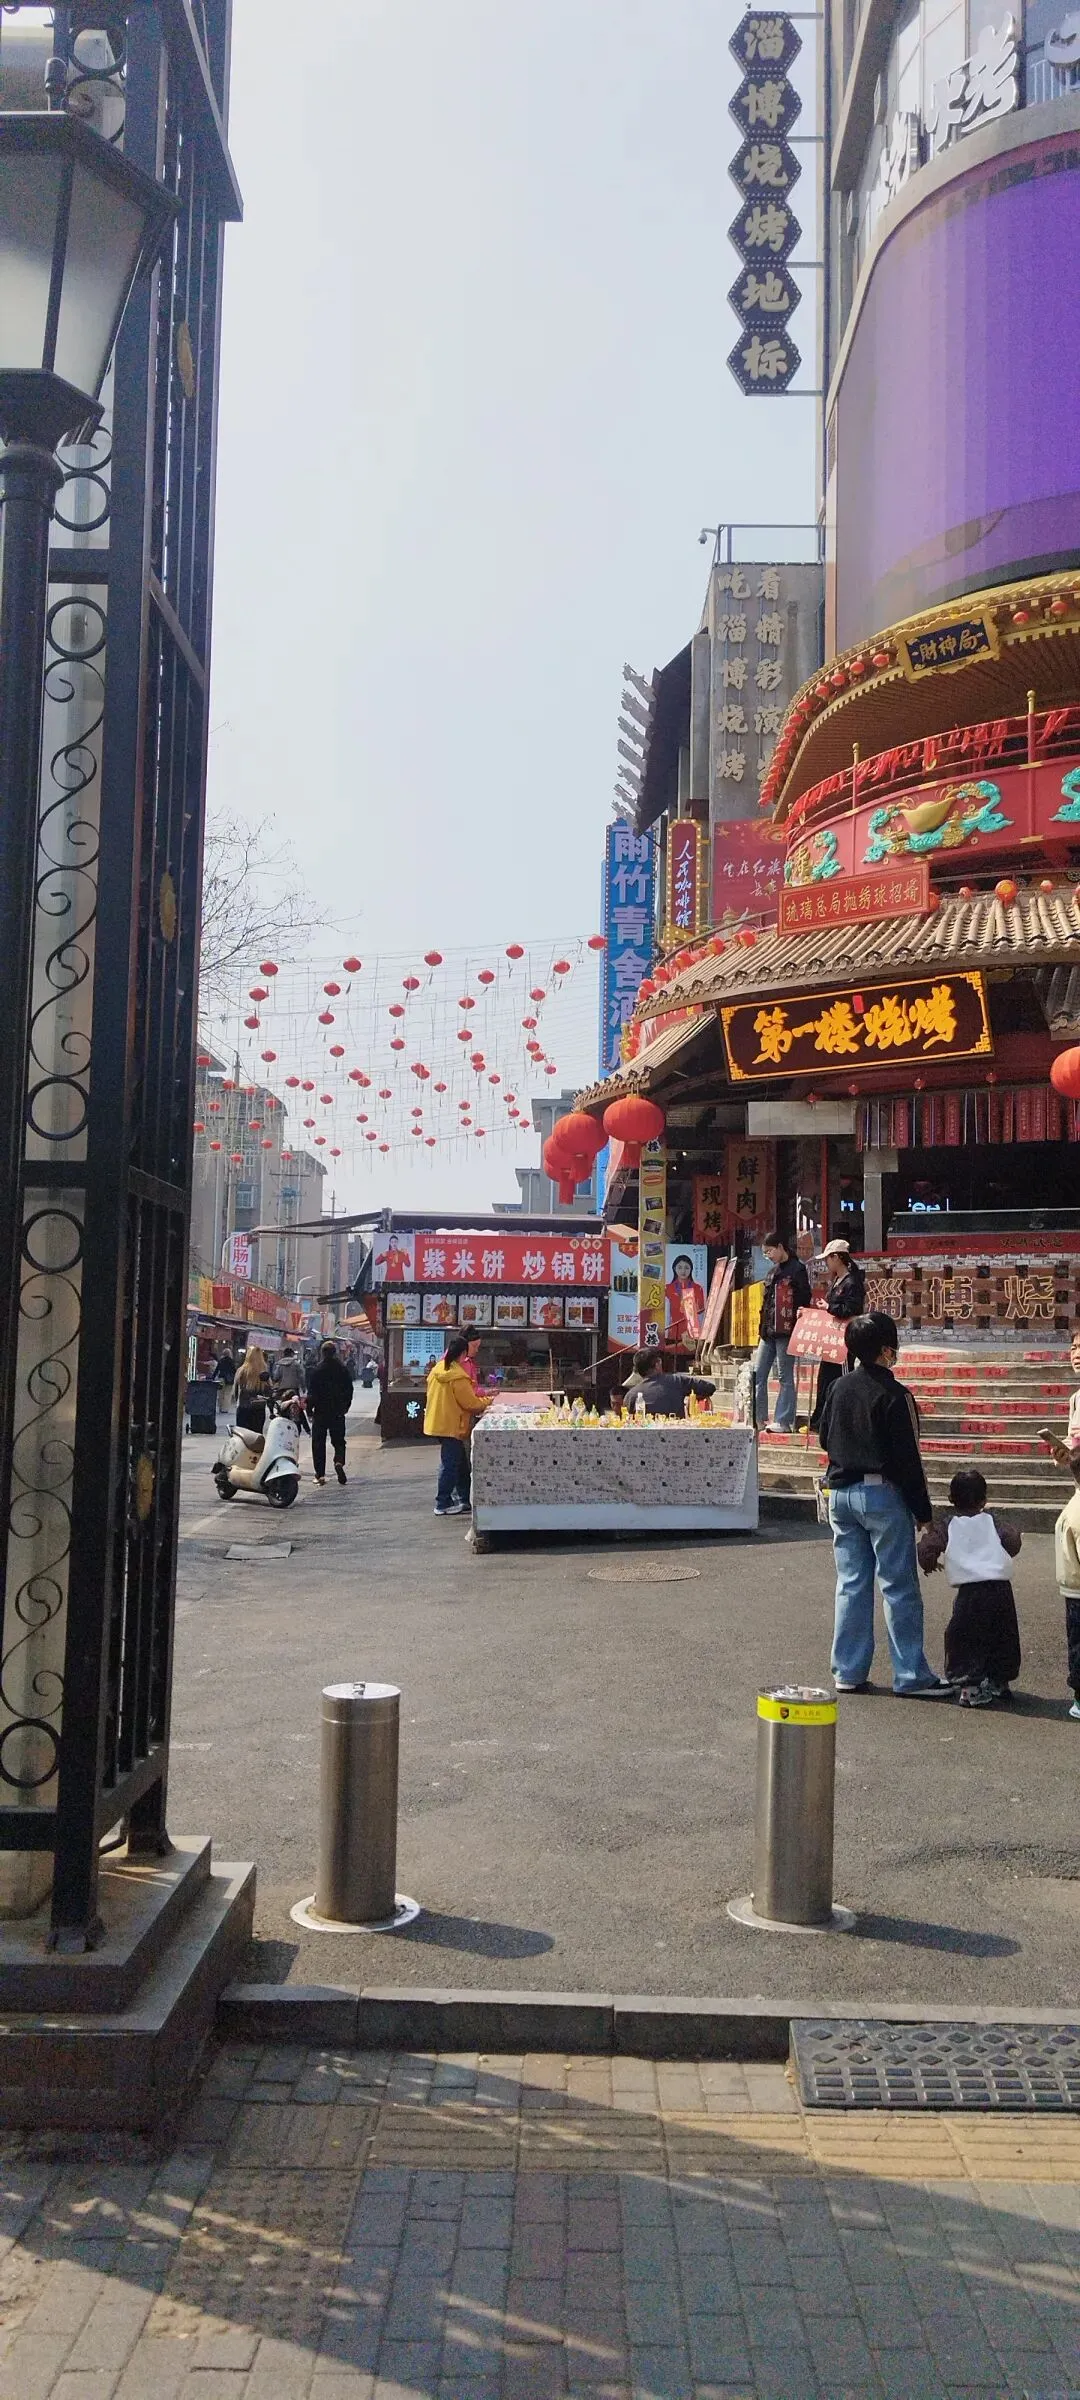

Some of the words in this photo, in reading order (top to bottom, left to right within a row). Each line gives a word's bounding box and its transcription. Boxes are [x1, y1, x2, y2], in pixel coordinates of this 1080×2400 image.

[741, 18, 789, 379] 淄博烧烤地标
[716, 567, 751, 782] 吃淄博烧烤
[674, 840, 694, 930] 人民咖啡馆
[785, 878, 920, 922] 琉璃总局抛绣球招婿
[752, 984, 957, 1064] 第一楼烧烤
[702, 1185, 722, 1232] 现烤
[737, 1157, 759, 1214] 鲜肉
[233, 1235, 249, 1278] 肥肠包
[422, 1248, 505, 1280] 紫米饼
[522, 1250, 605, 1282] 炒锅饼
[867, 1275, 1055, 1320] 淄博烧
